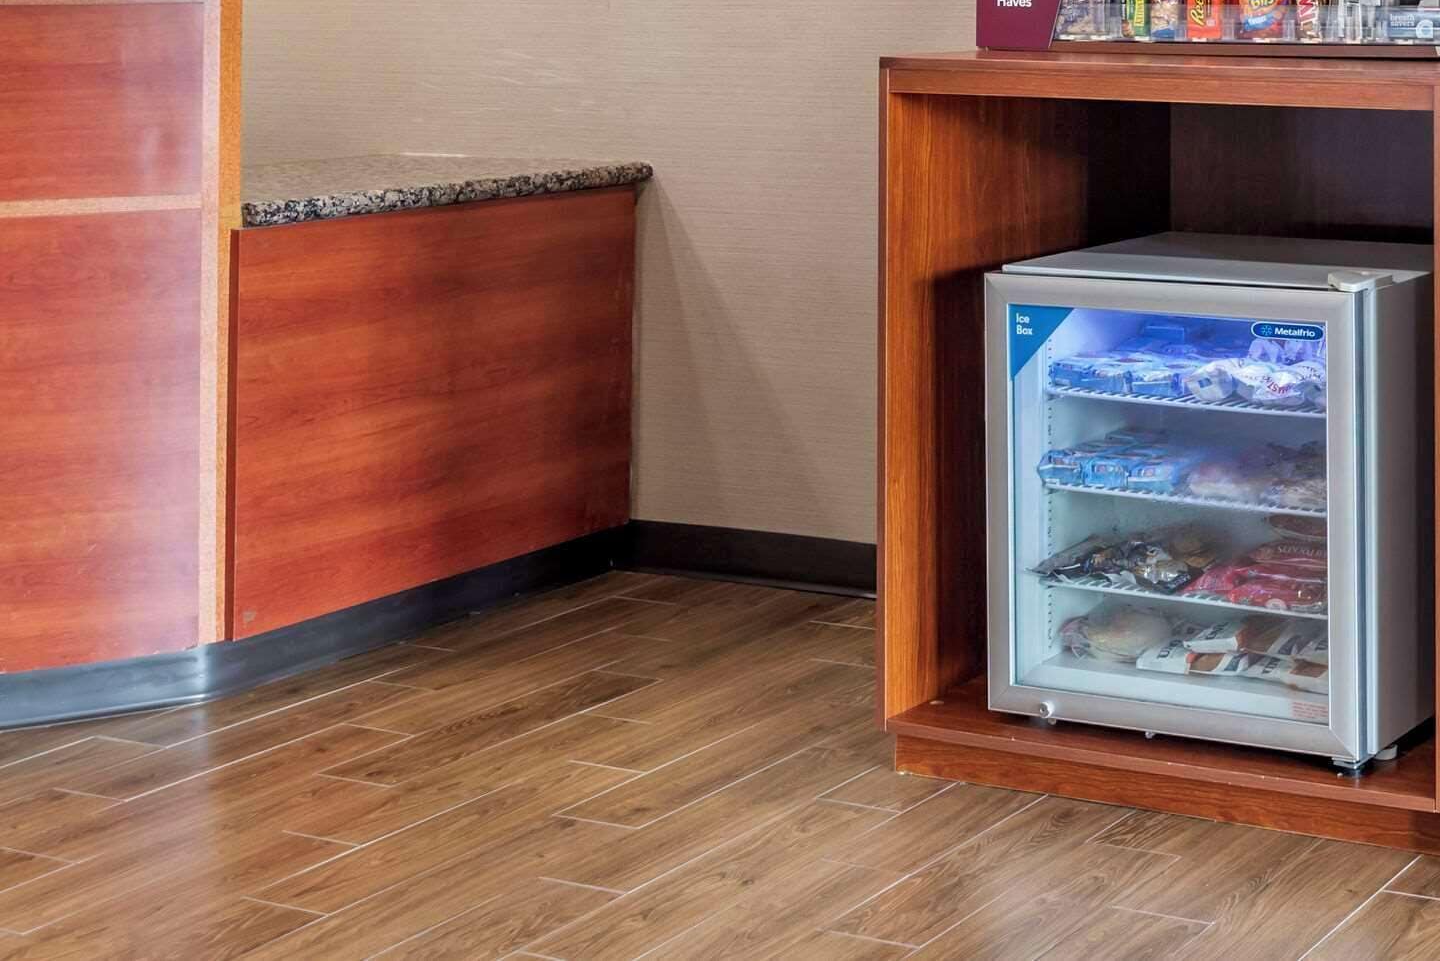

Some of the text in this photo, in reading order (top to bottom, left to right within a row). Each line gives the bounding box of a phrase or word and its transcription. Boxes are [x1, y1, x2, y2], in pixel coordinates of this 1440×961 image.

[1016, 312, 1030, 324] Ice
[1016, 324, 1033, 335] Box
[1274, 327, 1316, 337] Metalfrio
